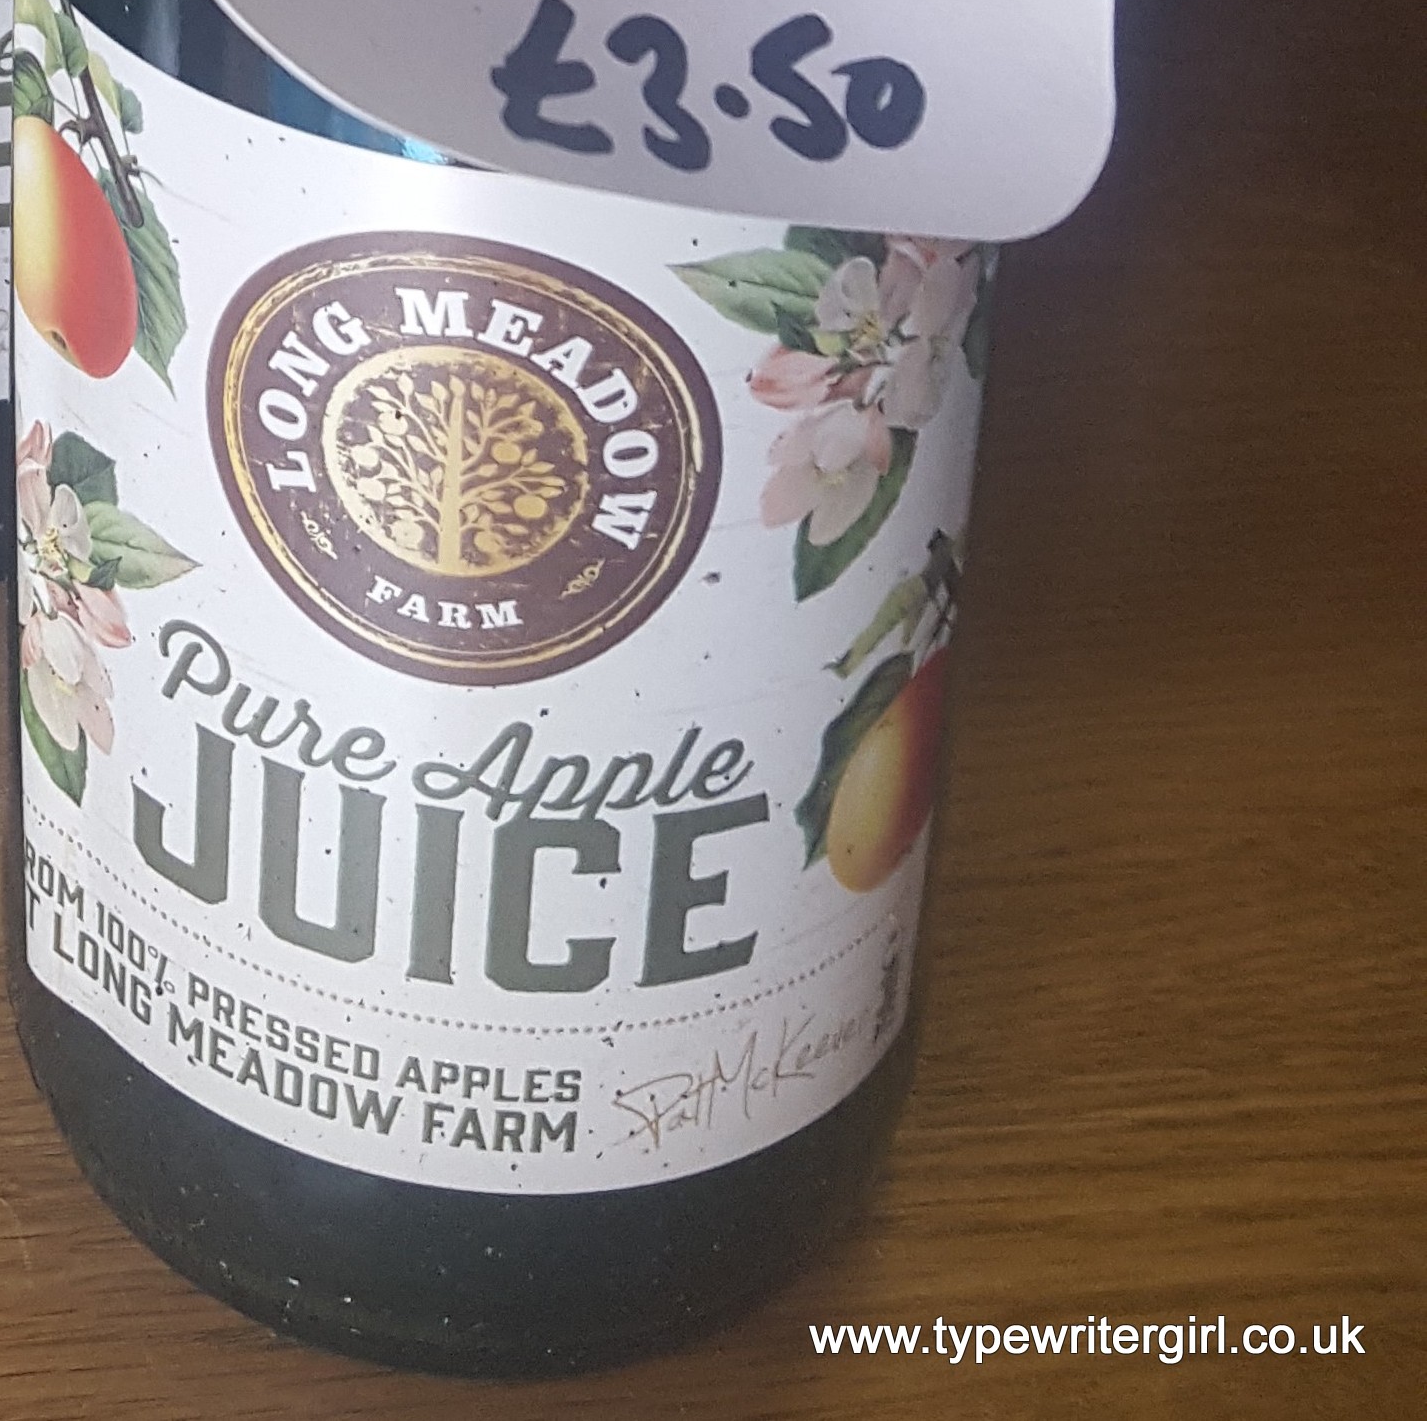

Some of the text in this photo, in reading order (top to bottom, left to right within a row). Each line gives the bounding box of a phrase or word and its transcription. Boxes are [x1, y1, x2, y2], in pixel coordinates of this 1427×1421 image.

[258, 286, 659, 552] LONG MEADOW
[157, 619, 757, 823] Pure Apple
[366, 574, 524, 630] FARM
[25, 836, 584, 1105] ROM 100% PRESSED APPLES
[130, 722, 772, 994] JUICE
[53, 911, 153, 1026] LONG
[168, 1001, 403, 1138] MEADOW
[421, 1102, 579, 1155] FARM
